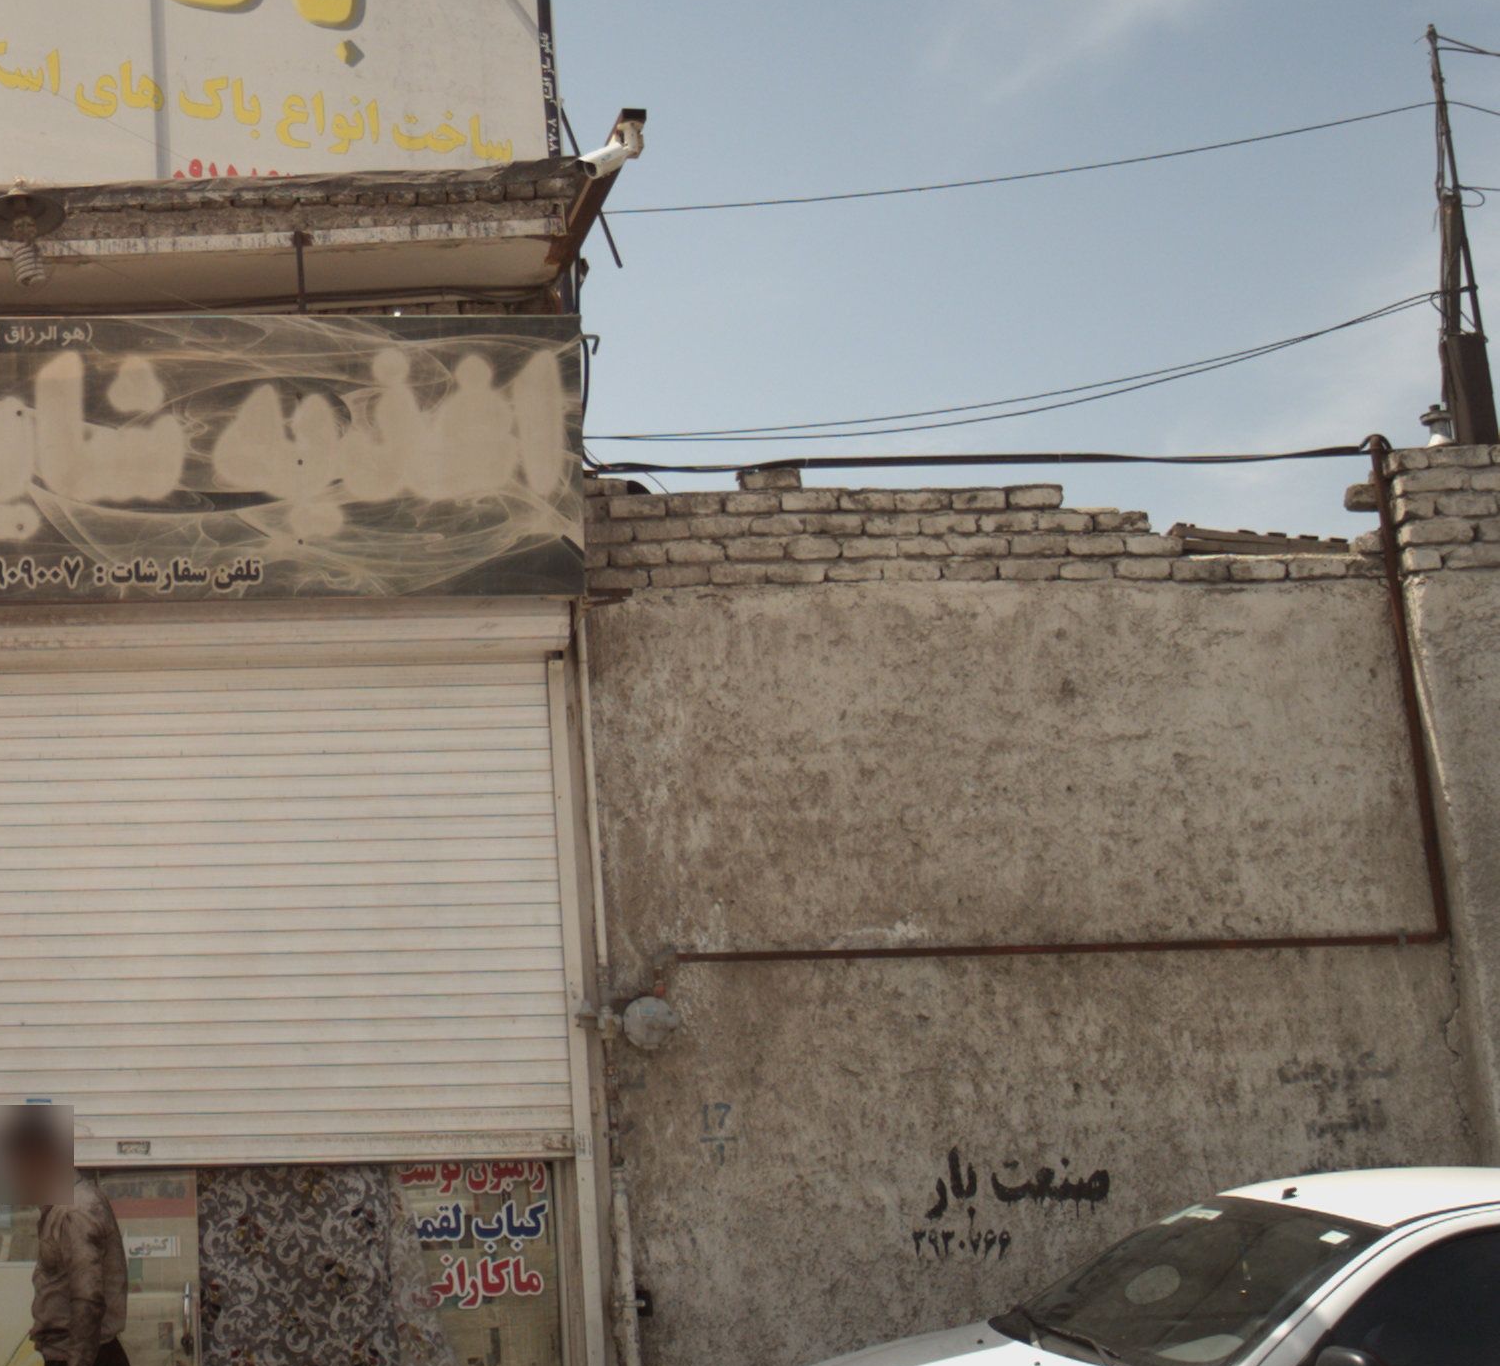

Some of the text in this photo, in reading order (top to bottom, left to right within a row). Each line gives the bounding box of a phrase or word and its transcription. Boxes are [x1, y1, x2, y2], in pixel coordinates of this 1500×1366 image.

[75, 60, 165, 120] های
[179, 75, 262, 140] باک
[275, 91, 380, 154] انواع
[391, 114, 514, 165] ساخت
[213, 557, 263, 590] تلفن
[925, 1145, 1110, 1221] صنعت بار
[414, 1200, 548, 1253] کباب لقم
